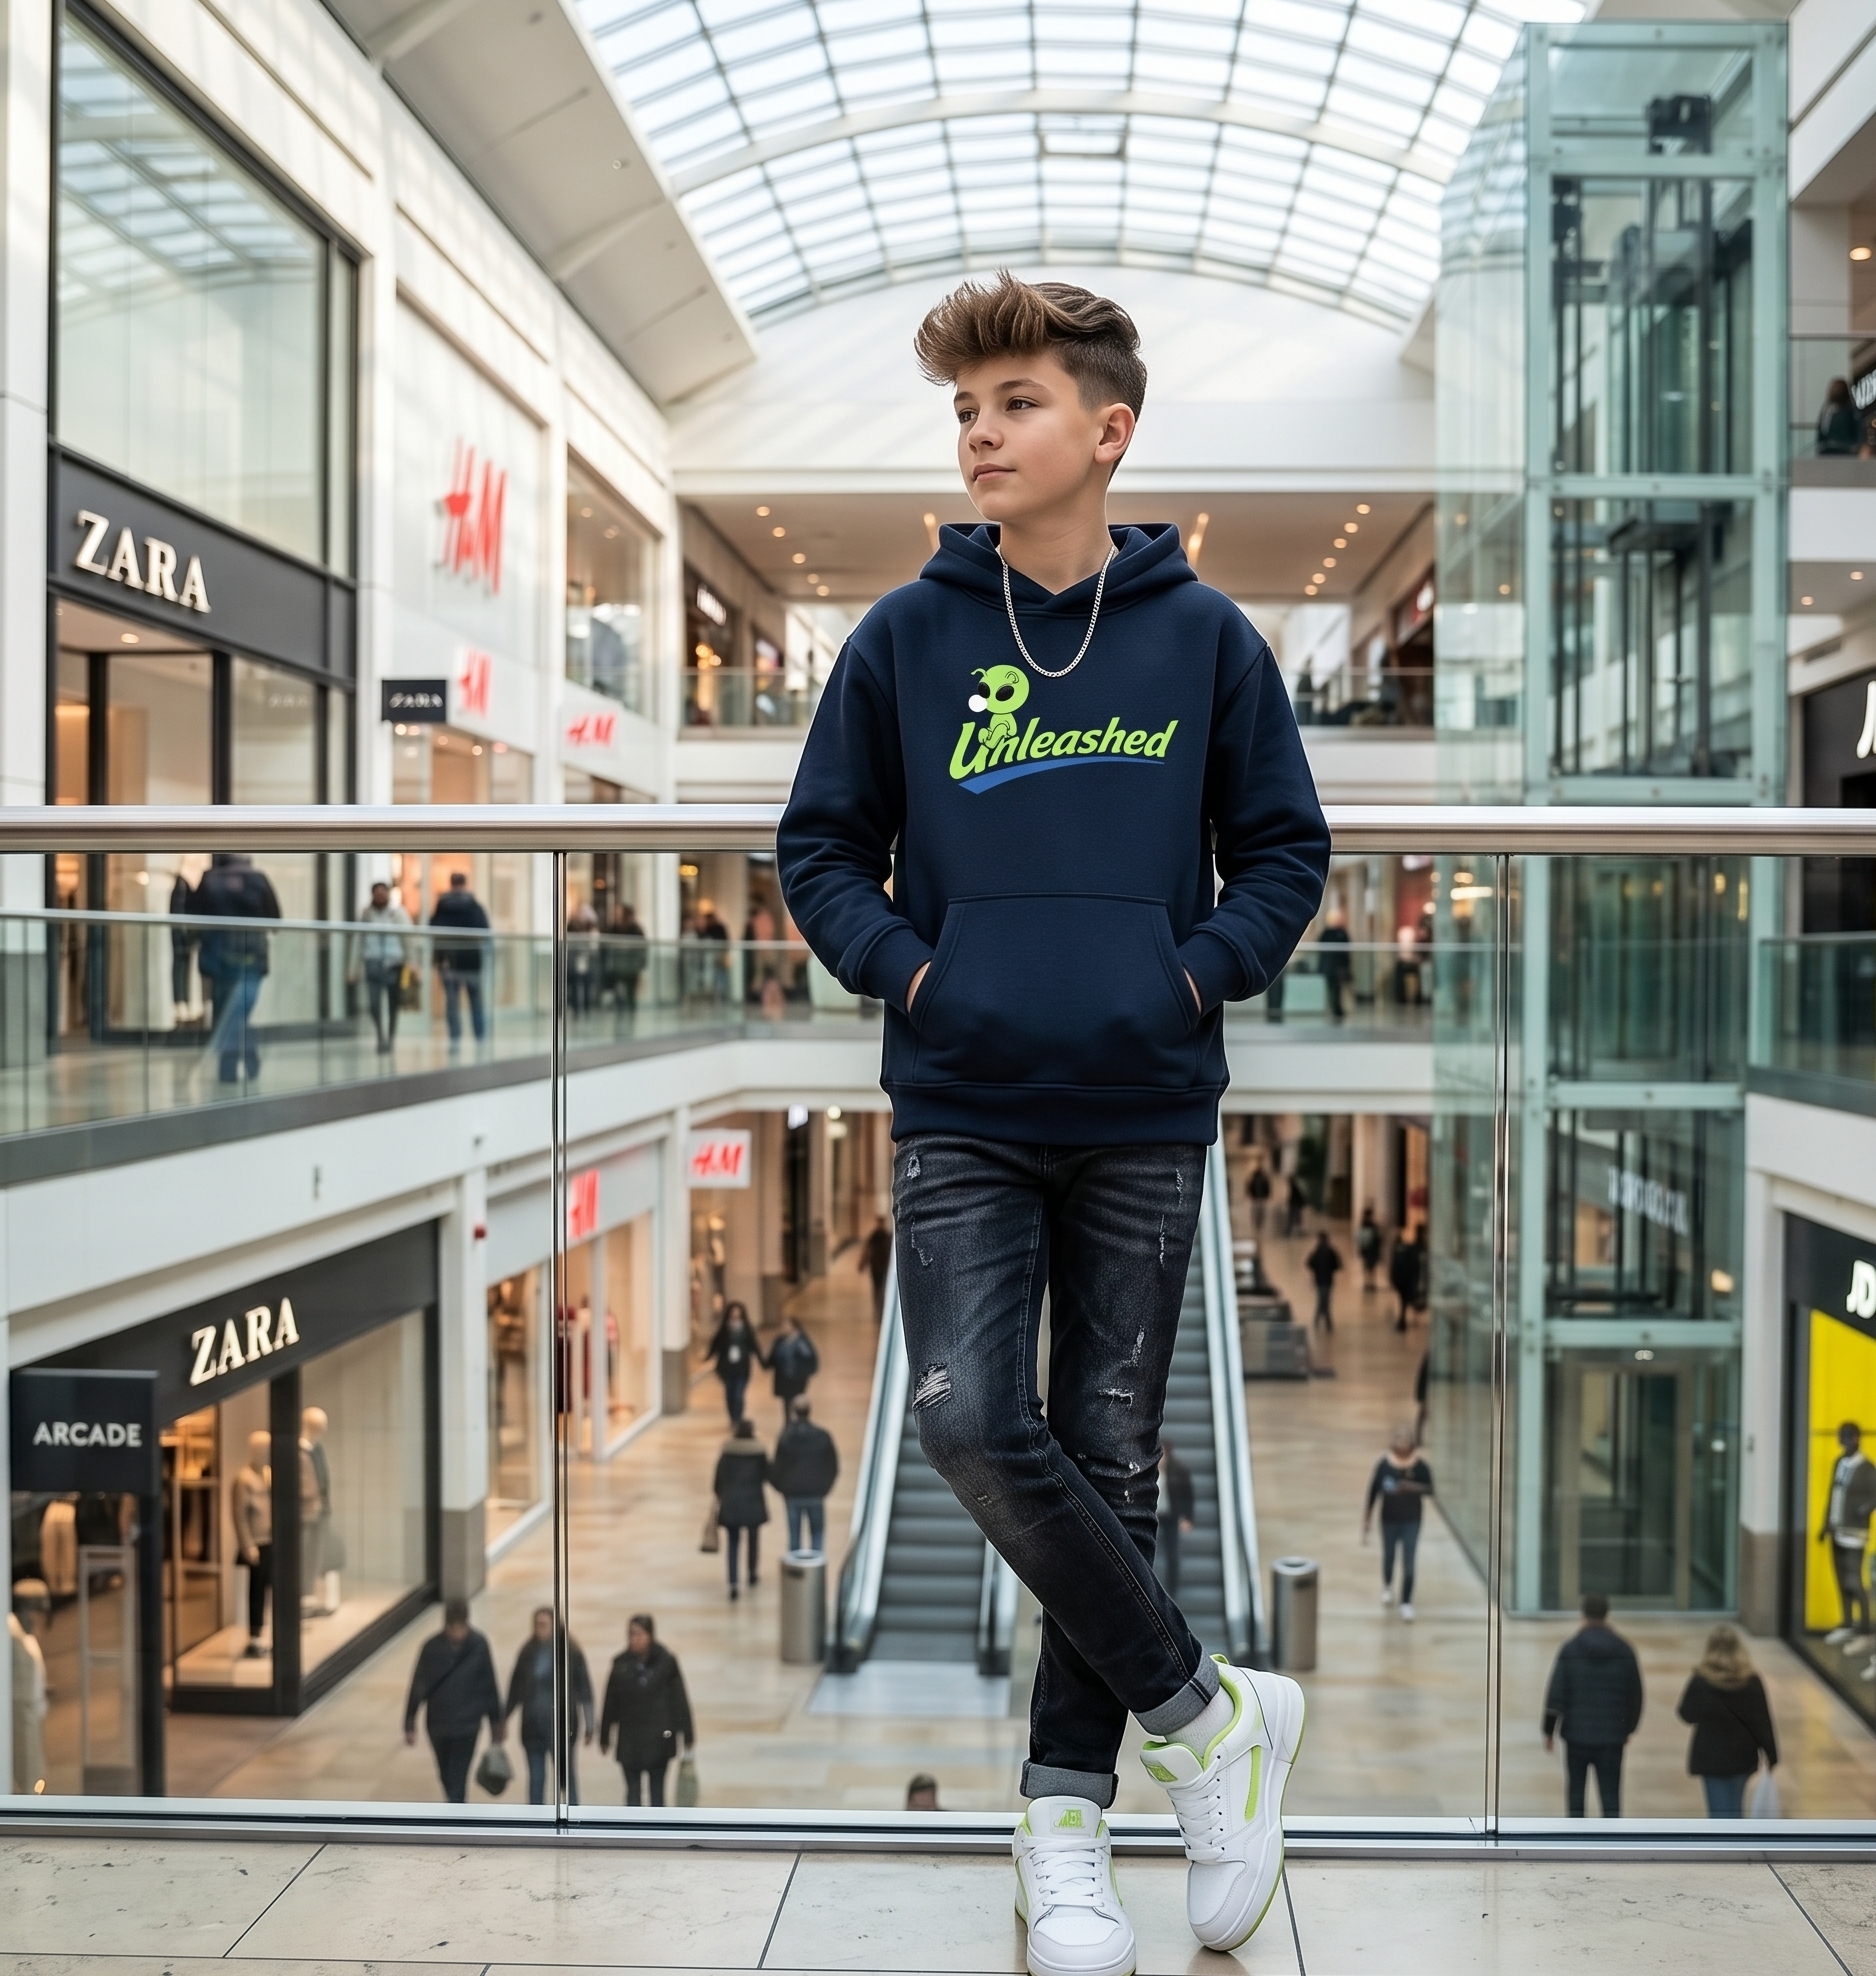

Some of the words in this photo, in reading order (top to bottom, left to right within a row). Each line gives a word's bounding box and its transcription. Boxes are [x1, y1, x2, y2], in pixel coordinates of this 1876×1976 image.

[74, 509, 212, 614] ZARA
[949, 716, 1180, 780] Unleashed
[692, 1143, 744, 1177] HM
[1846, 1259, 1876, 1319] JD
[189, 1296, 300, 1387] ZARA
[32, 1421, 143, 1448] ARCADE
